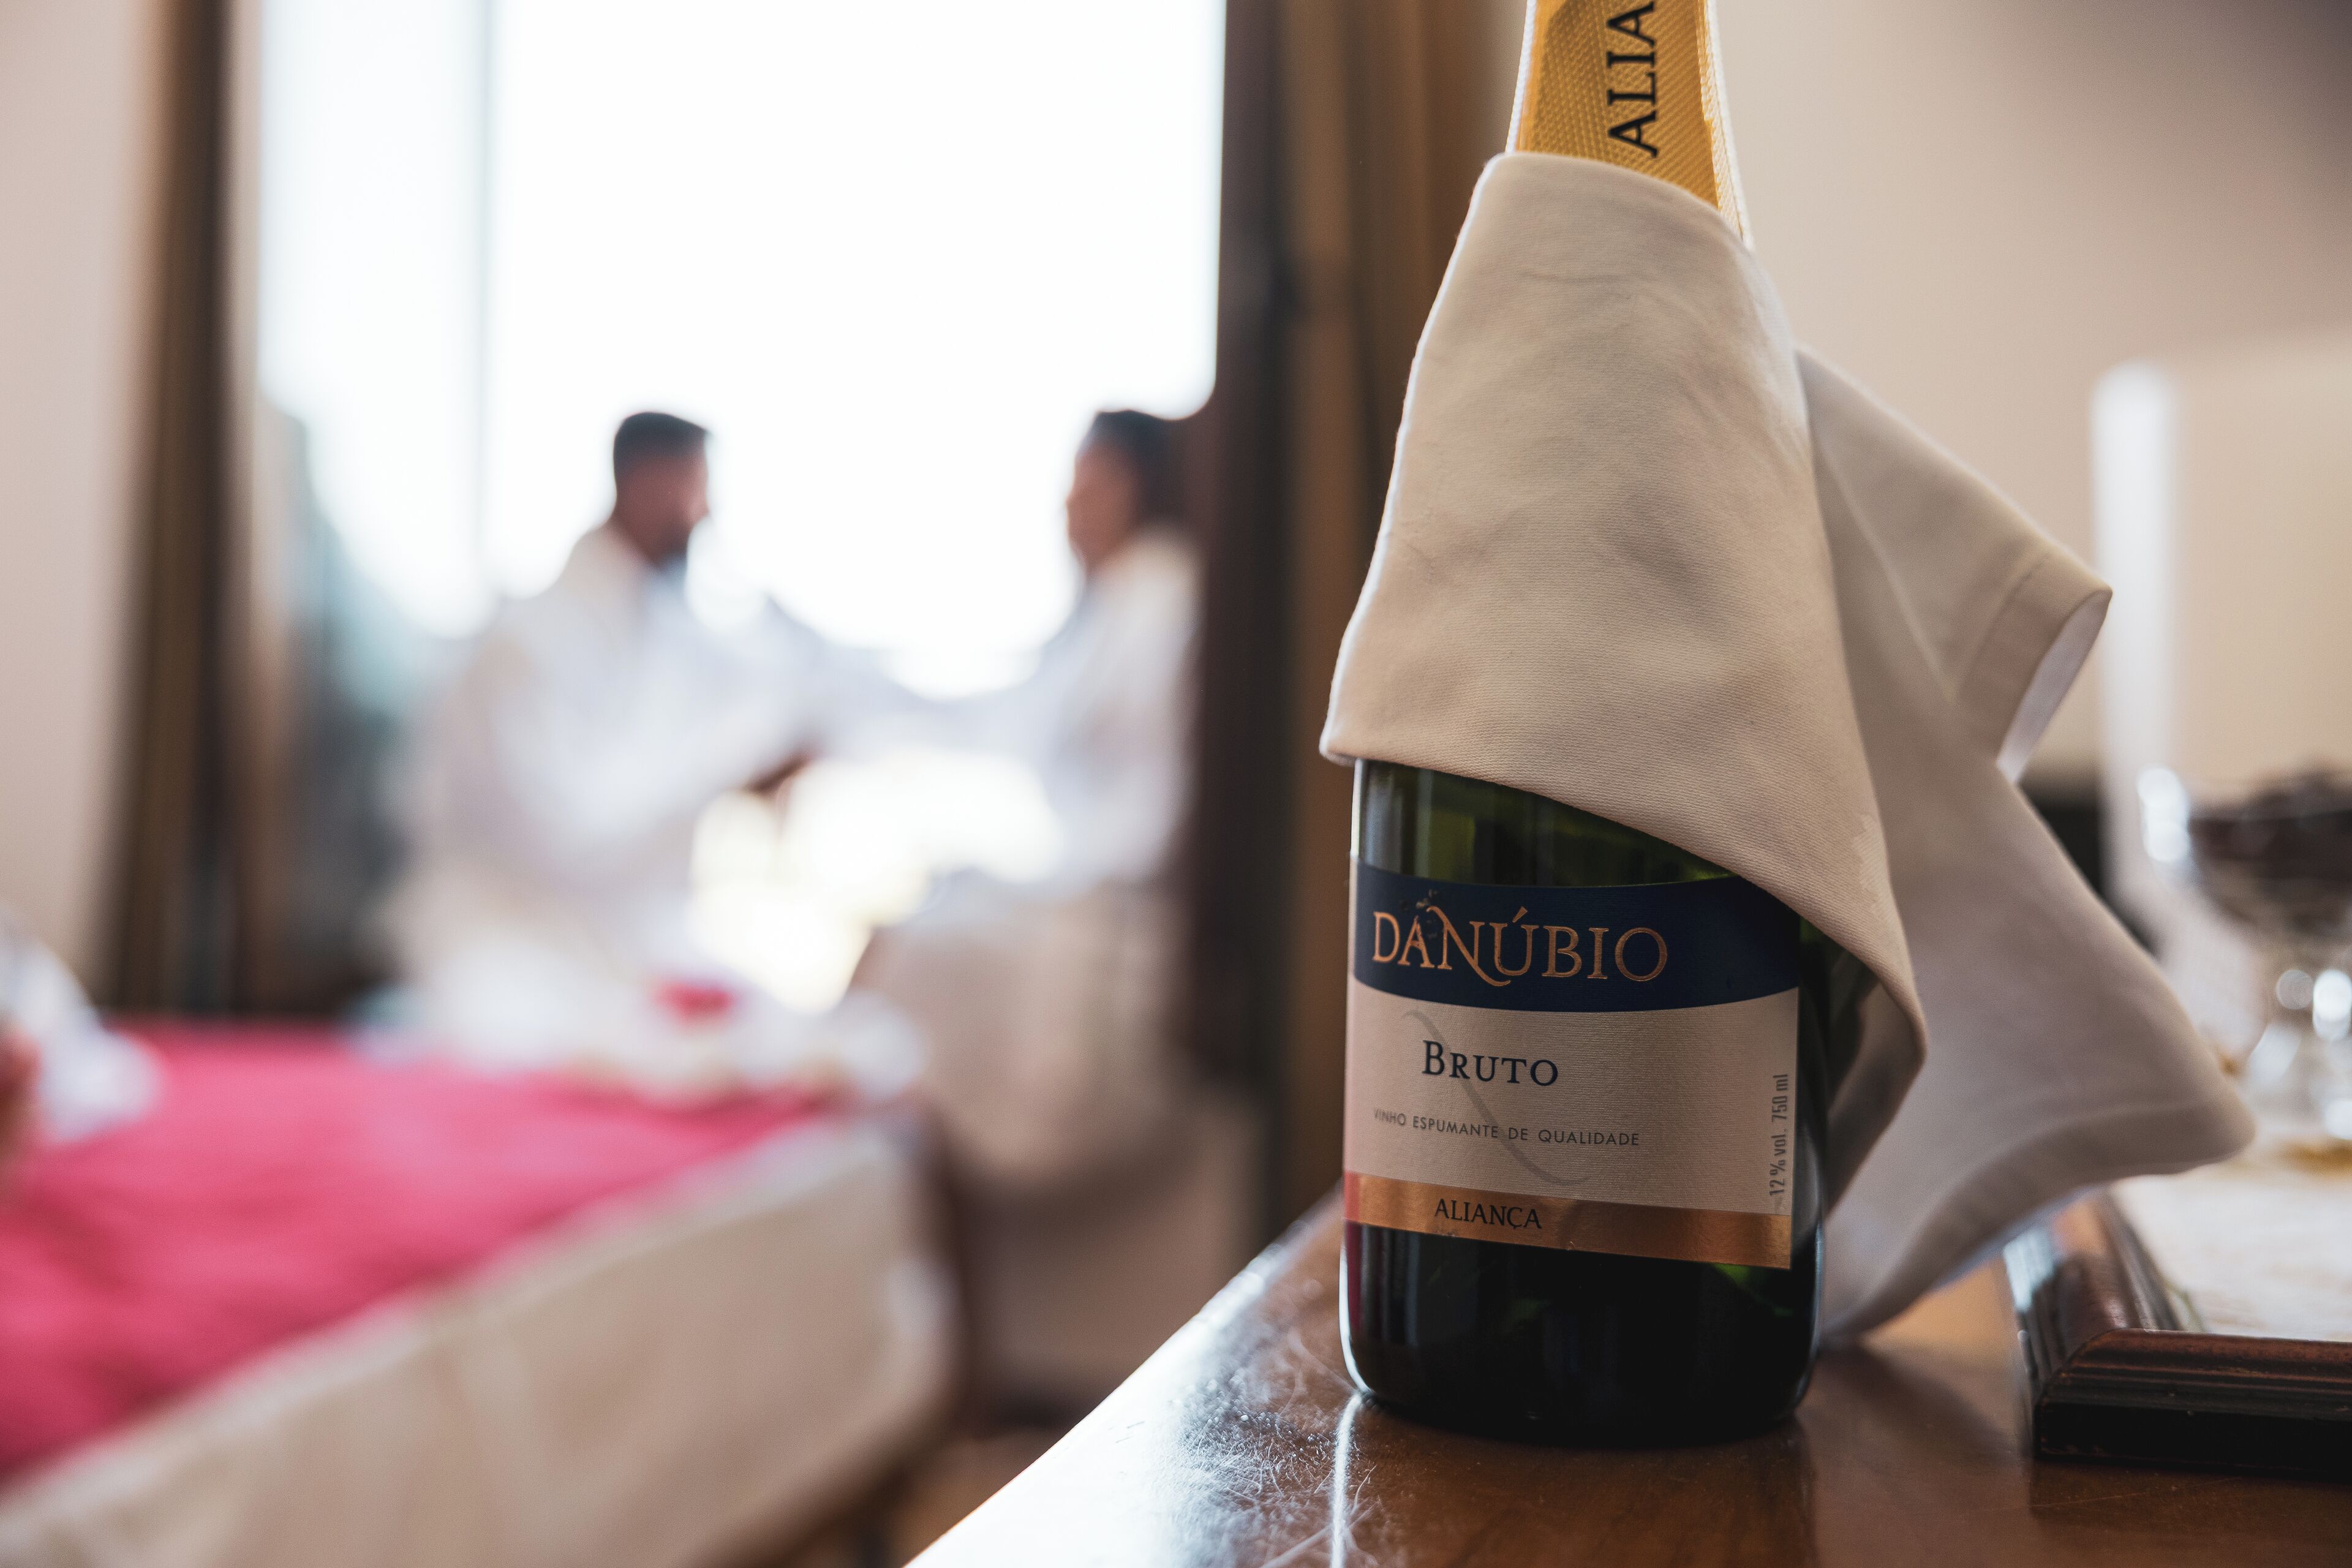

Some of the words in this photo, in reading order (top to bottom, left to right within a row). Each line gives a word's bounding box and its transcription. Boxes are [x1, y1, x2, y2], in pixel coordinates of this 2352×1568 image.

[1605, 0, 1659, 159] ALIA
[1372, 905, 1668, 987] DANÚBIO
[1422, 1039, 1559, 1087] BRUTO
[1772, 1074, 1789, 1091] ml
[1373, 1107, 1407, 1126] VINHO
[1412, 1115, 1499, 1139] ESPUMANTE
[1508, 1127, 1529, 1141] DE
[1537, 1129, 1640, 1147] QUALIDADE
[1771, 1095, 1788, 1123] 750
[1434, 1197, 1542, 1229] ALIANÇA
